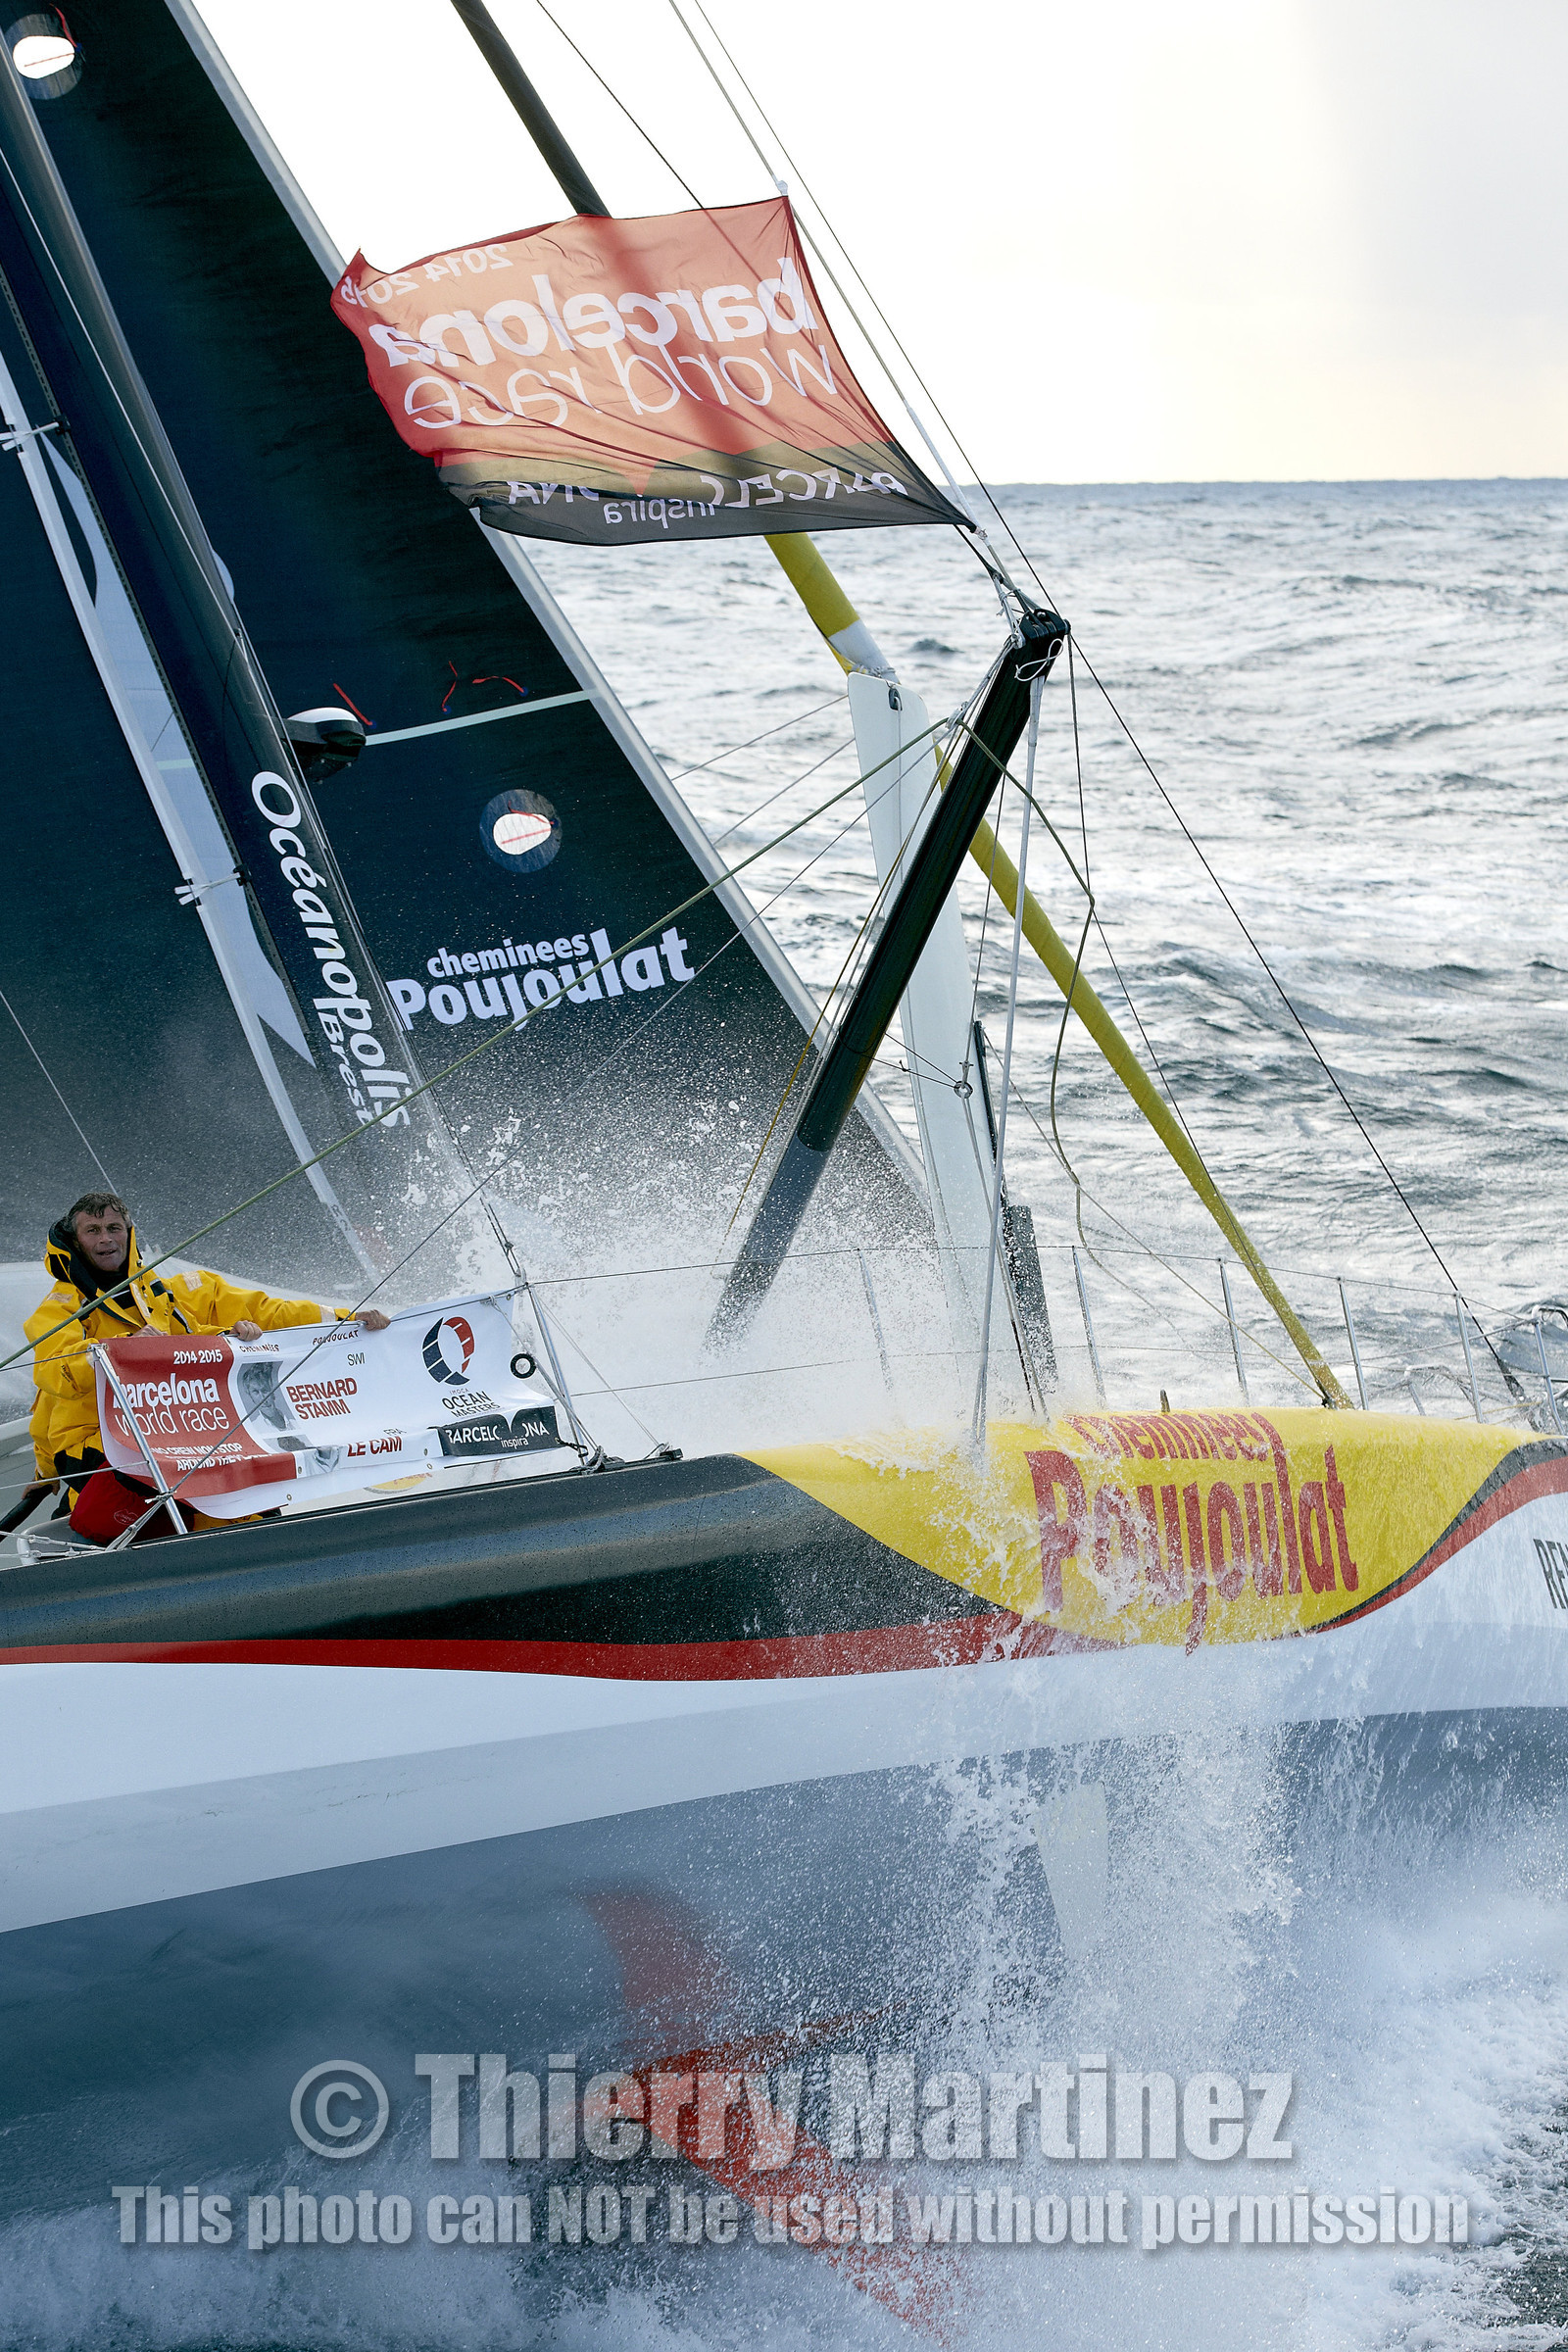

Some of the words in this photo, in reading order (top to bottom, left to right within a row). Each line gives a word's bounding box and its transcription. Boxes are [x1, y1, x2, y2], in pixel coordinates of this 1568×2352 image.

[251, 770, 413, 1128] Océanopolis
[426, 933, 590, 979] cheminees
[385, 926, 696, 1032] Poujoulat
[173, 1350, 197, 1365] 2014
[199, 1349, 223, 1364] 2015
[347, 1352, 366, 1366] SWI
[286, 1378, 358, 1403] BERNARD
[442, 1391, 492, 1410] OCEAN
[179, 1405, 230, 1433] race
[295, 1399, 352, 1420] STAMM
[451, 1401, 501, 1417] MASTERS
[347, 1442, 367, 1457] LE
[368, 1436, 402, 1454] CAM
[501, 1436, 529, 1449] inspira
